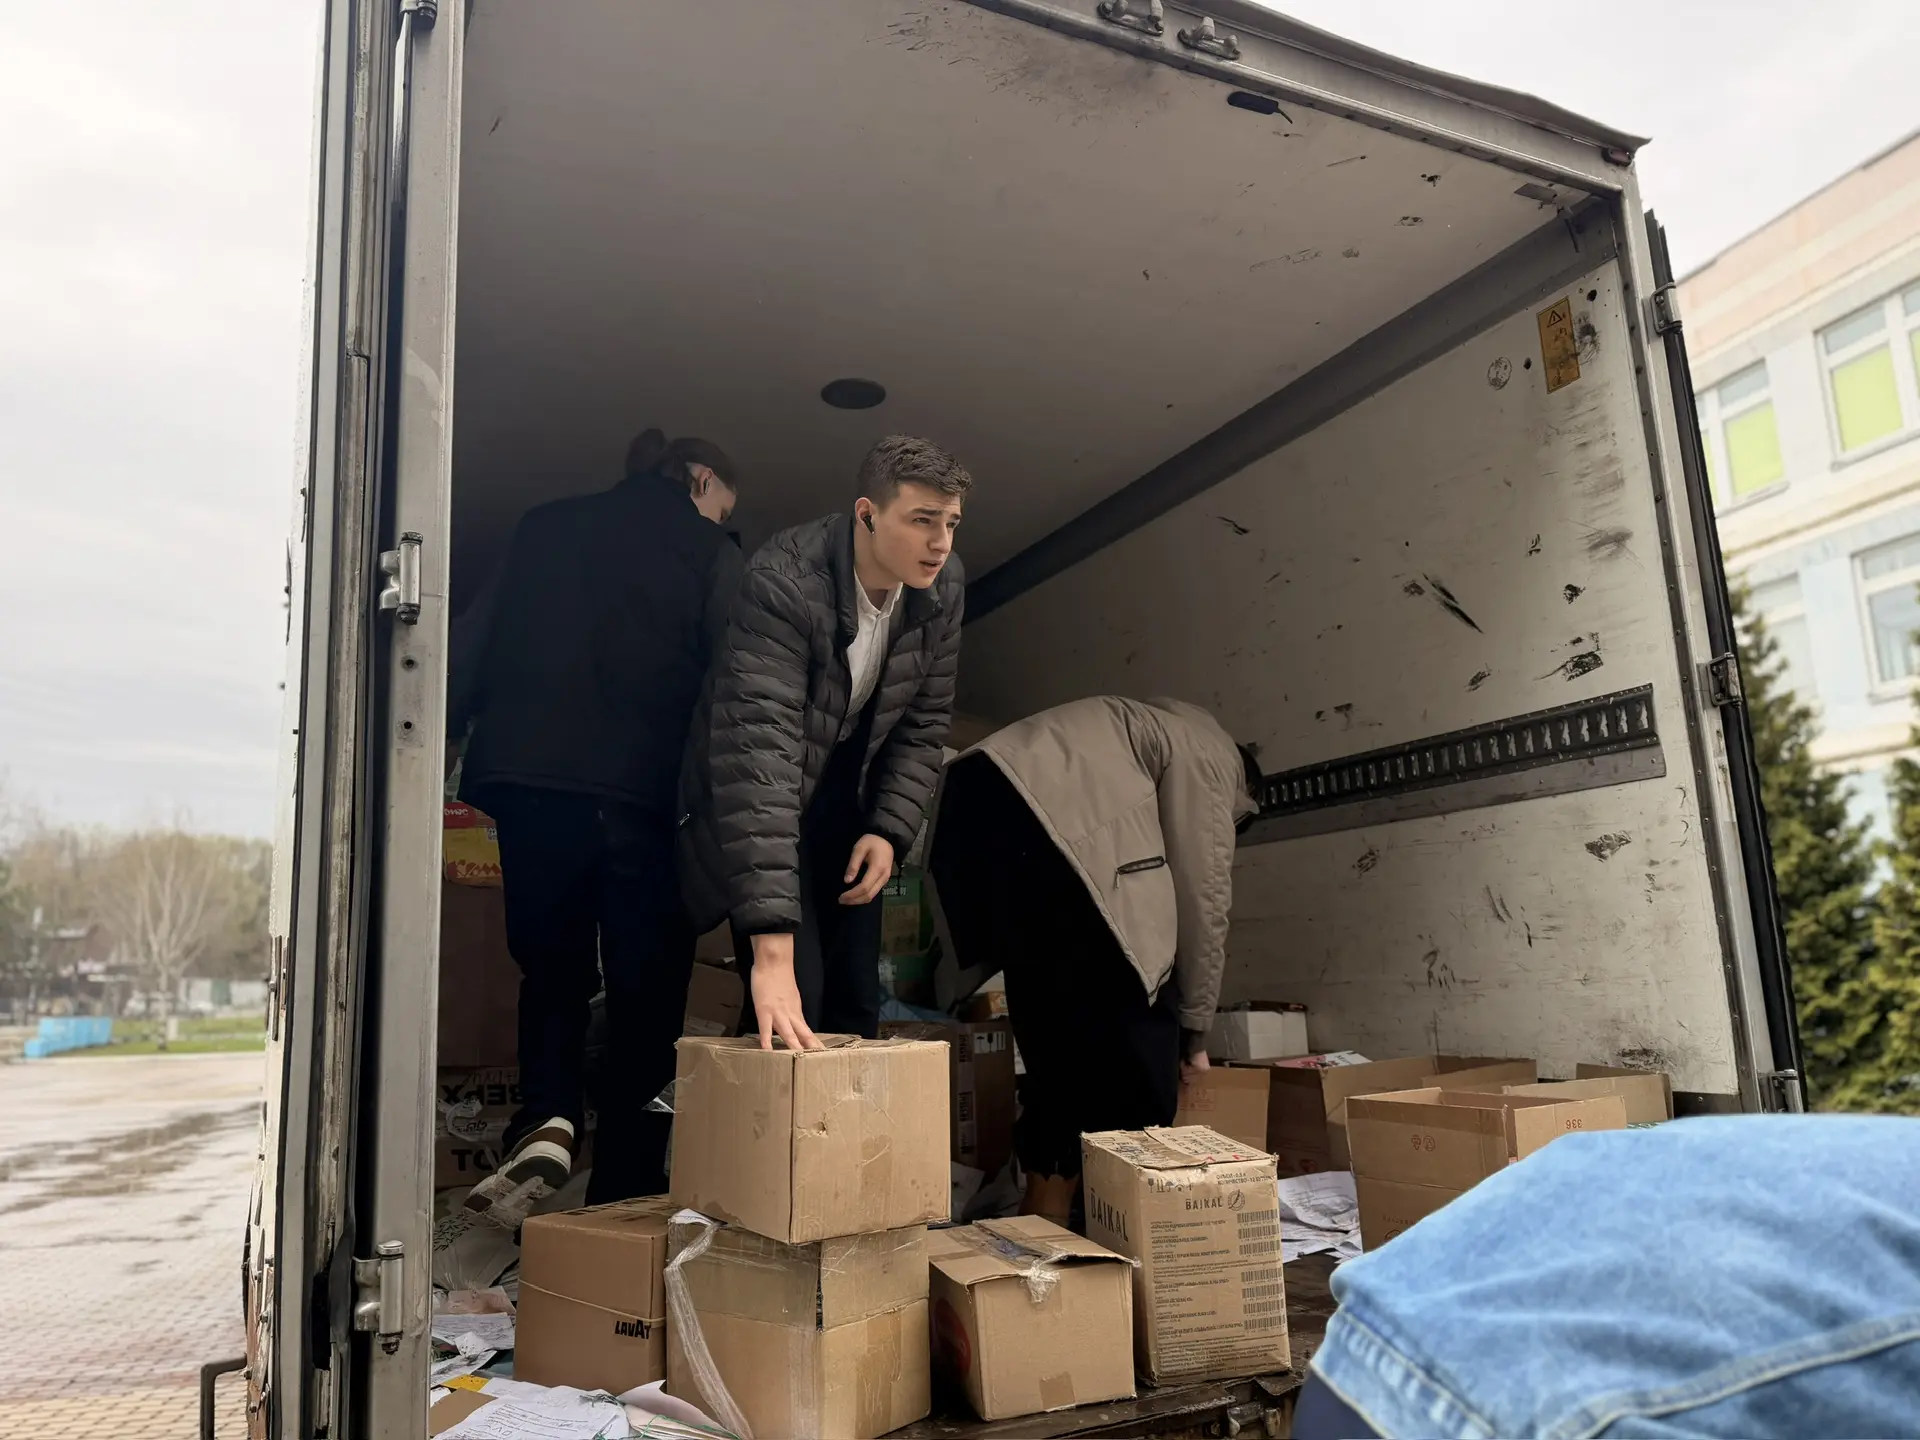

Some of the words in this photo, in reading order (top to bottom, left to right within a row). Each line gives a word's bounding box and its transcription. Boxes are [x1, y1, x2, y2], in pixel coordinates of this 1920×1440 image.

[1565, 1118, 1583, 1130] 336
[1185, 1197, 1224, 1210] BAIKAL
[1090, 1188, 1129, 1242] BAIKAL
[614, 1319, 652, 1340] LAVAT
